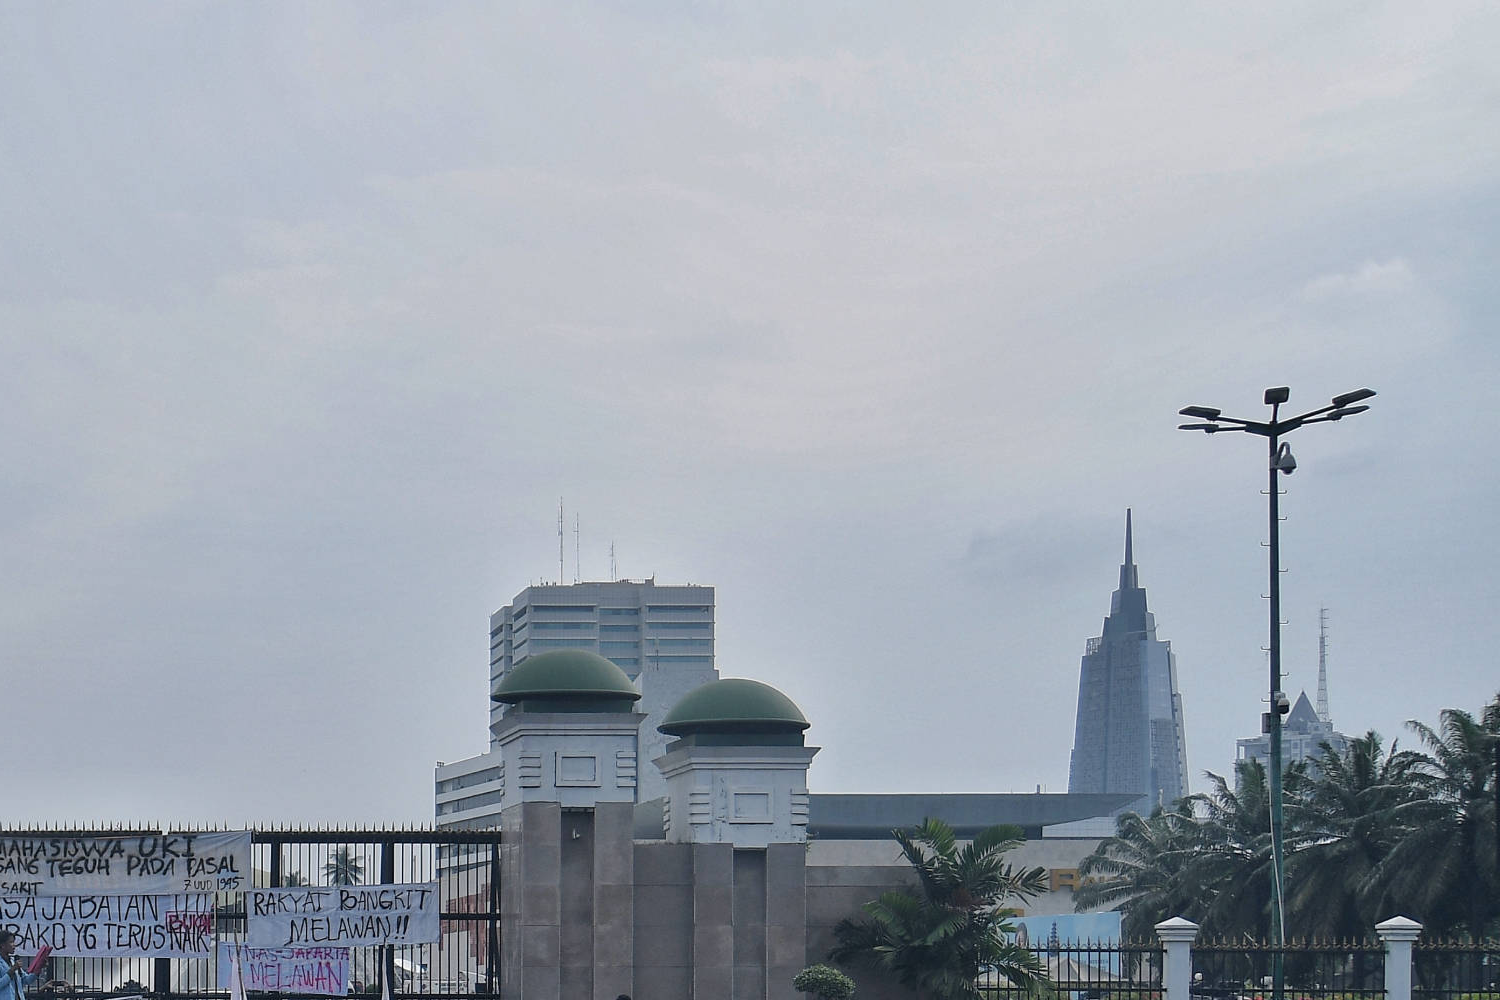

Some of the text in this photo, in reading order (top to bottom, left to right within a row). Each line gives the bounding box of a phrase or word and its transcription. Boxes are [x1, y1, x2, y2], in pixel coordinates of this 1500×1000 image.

[138, 835, 197, 858] UKI
[45, 857, 111, 878] TEGUH
[126, 856, 175, 876] PADA
[186, 855, 239, 877] PASAL
[1, 882, 44, 896] SAKIT
[184, 876, 245, 891] 7 UUD 1945
[253, 889, 432, 916] RAKYAT BANGKIT
[72, 923, 97, 952] YG
[103, 923, 166, 950] TERUS
[169, 924, 210, 953] NAIK
[283, 915, 409, 946] MELAWAN!!
